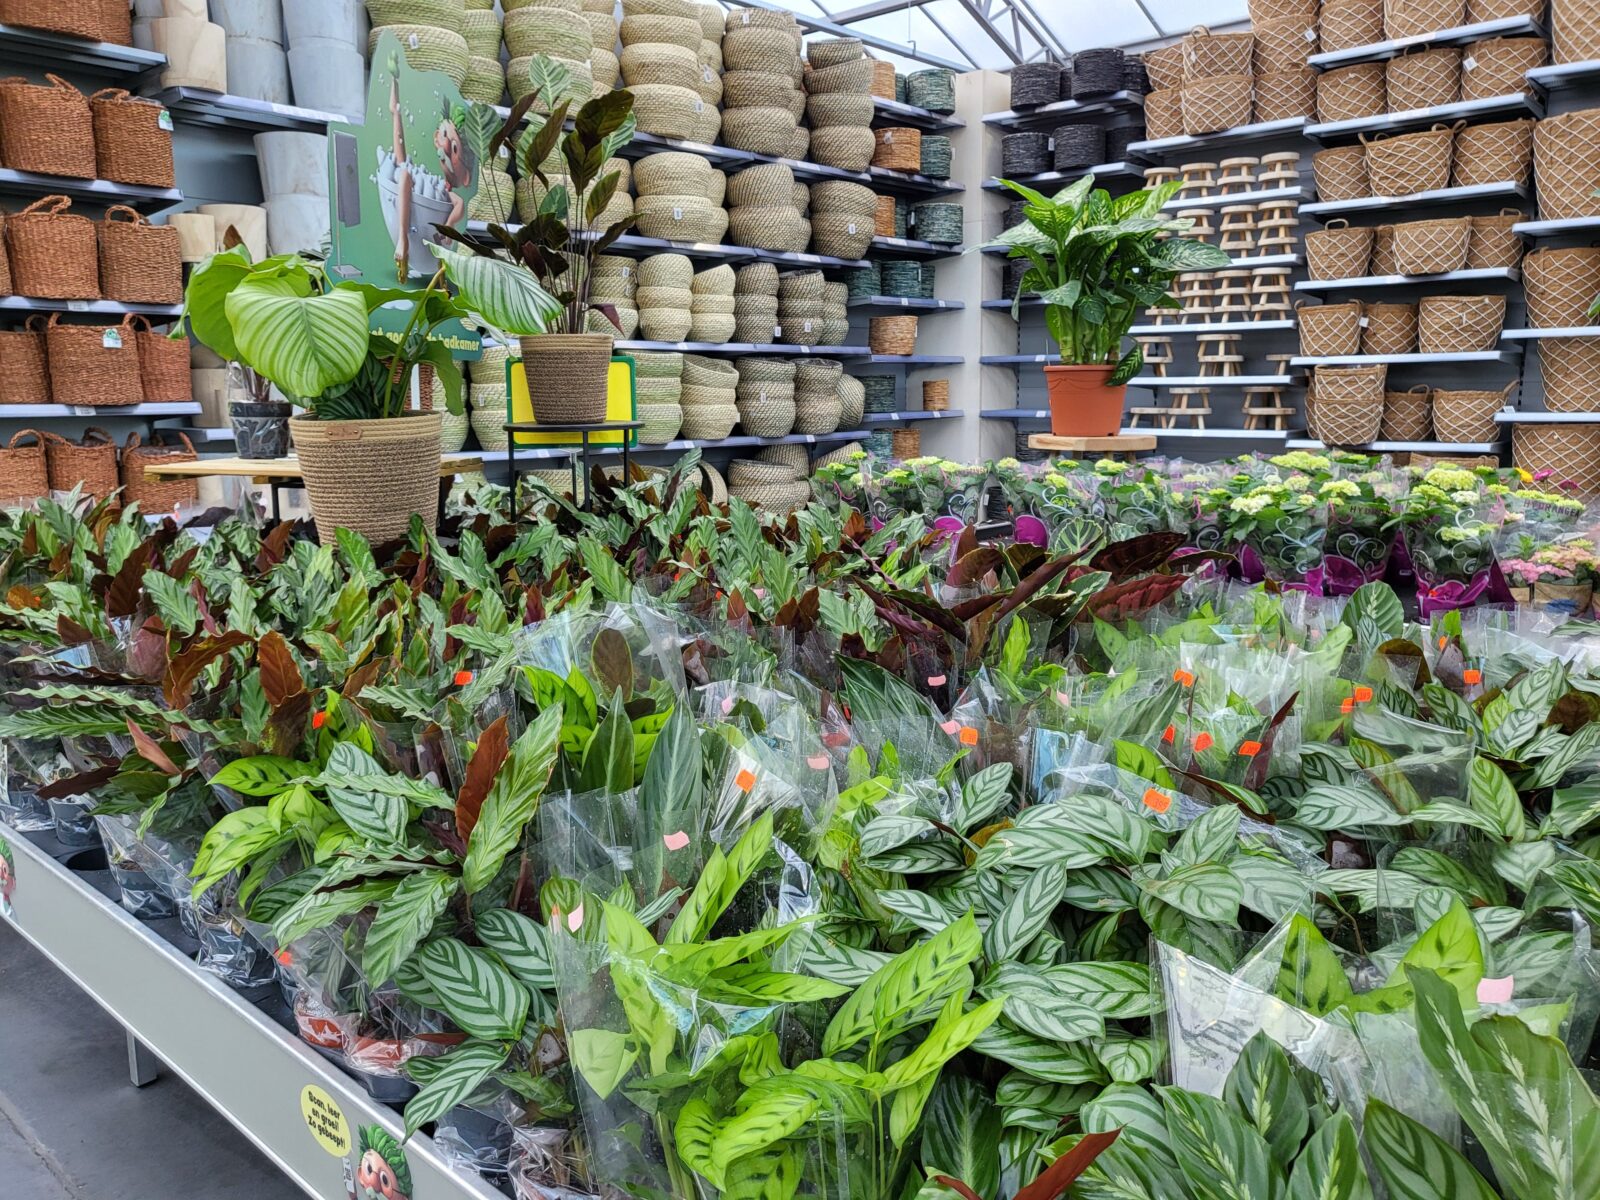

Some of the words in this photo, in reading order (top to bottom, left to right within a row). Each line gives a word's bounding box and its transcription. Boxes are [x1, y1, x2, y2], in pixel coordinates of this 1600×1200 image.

[439, 333, 480, 352] badkamer
[1523, 499, 1581, 518] HYDRANGEA
[308, 1090, 326, 1113] Scan,
[327, 1103, 340, 1120] leer
[312, 1107, 320, 1119] en
[308, 1114, 316, 1129] Zo
